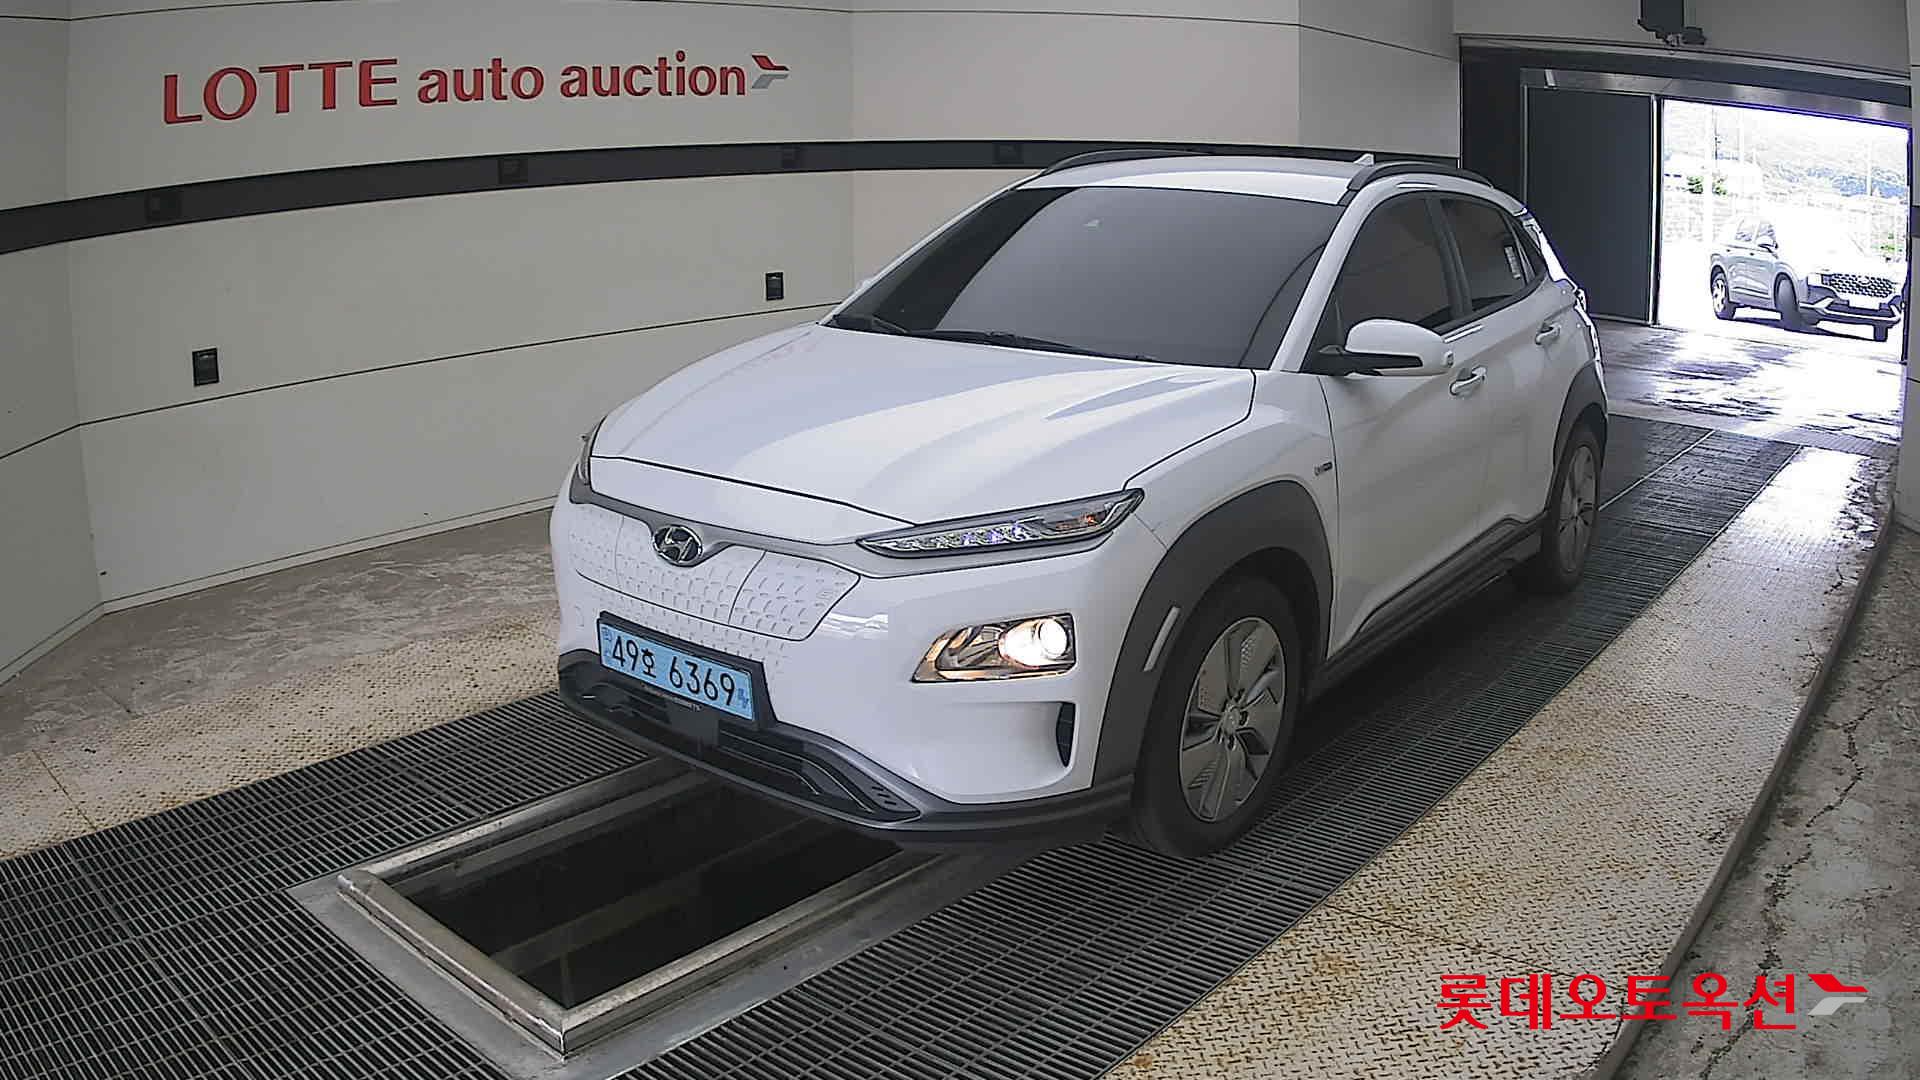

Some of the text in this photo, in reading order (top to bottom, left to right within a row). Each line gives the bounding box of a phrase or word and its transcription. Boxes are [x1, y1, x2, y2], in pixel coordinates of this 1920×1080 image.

[163, 51, 747, 125] LOTTE auto auction
[612, 636, 657, 678] 49호
[669, 656, 735, 706] 6369
